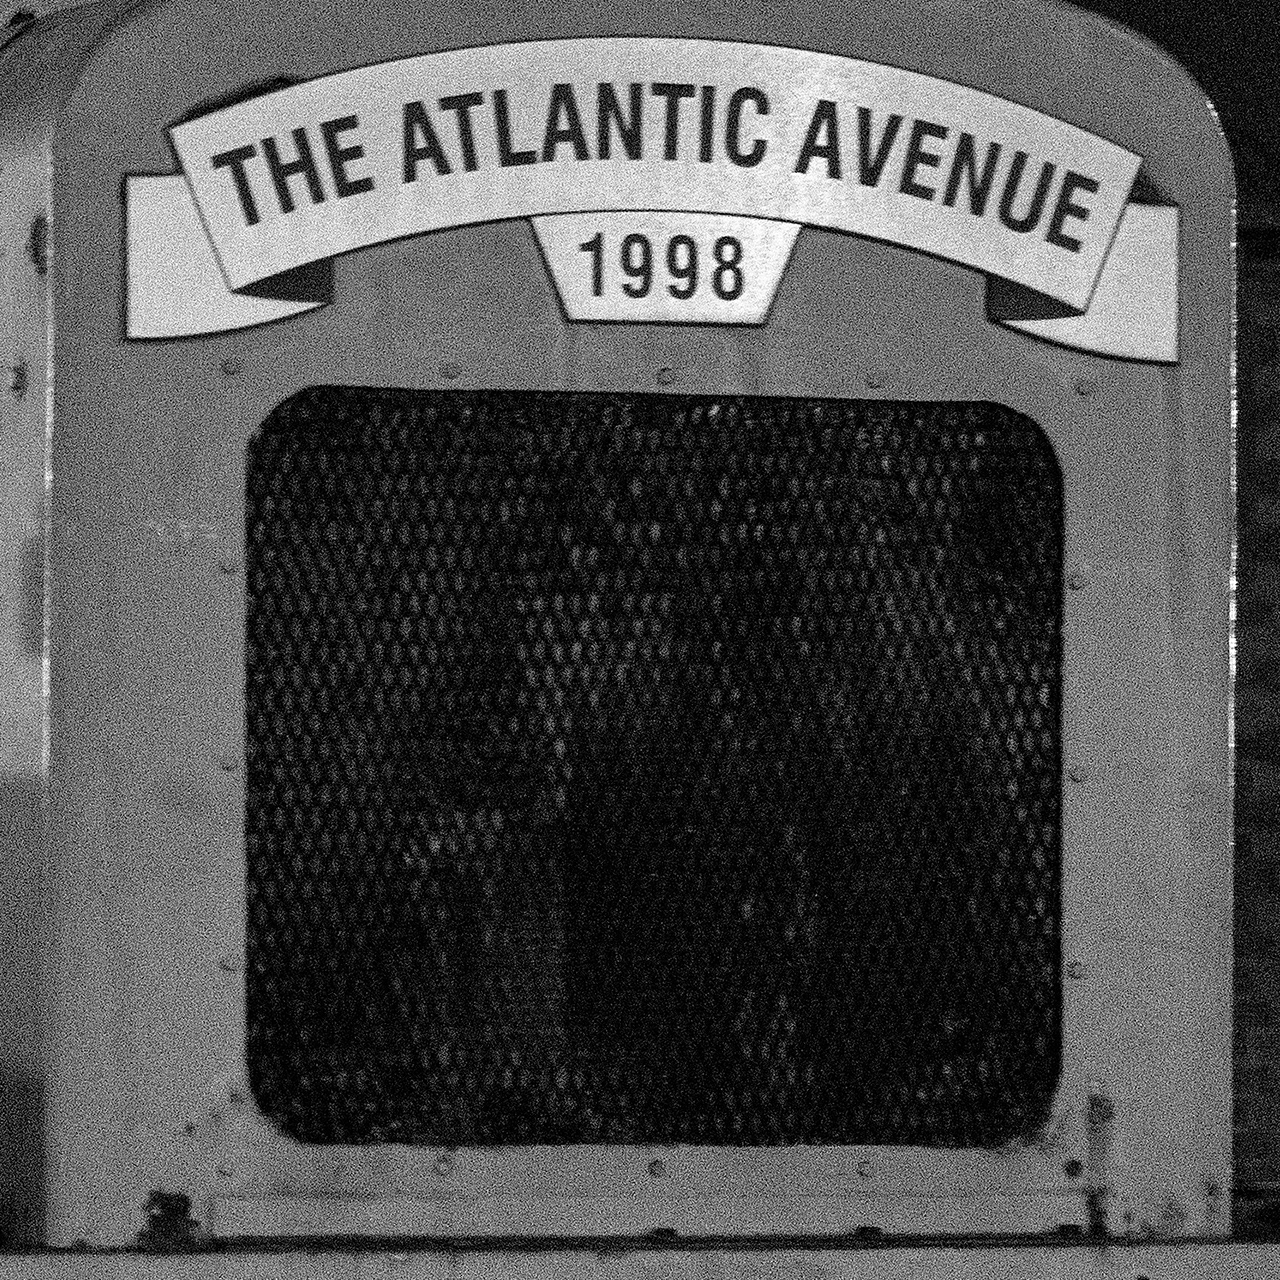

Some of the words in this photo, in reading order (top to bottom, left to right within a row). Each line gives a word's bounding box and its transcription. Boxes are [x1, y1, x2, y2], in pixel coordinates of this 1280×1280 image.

[211, 114, 374, 226] THE
[400, 81, 771, 183] ATLANTIC
[793, 99, 1100, 253] AVENUE
[578, 232, 746, 301] 1998
